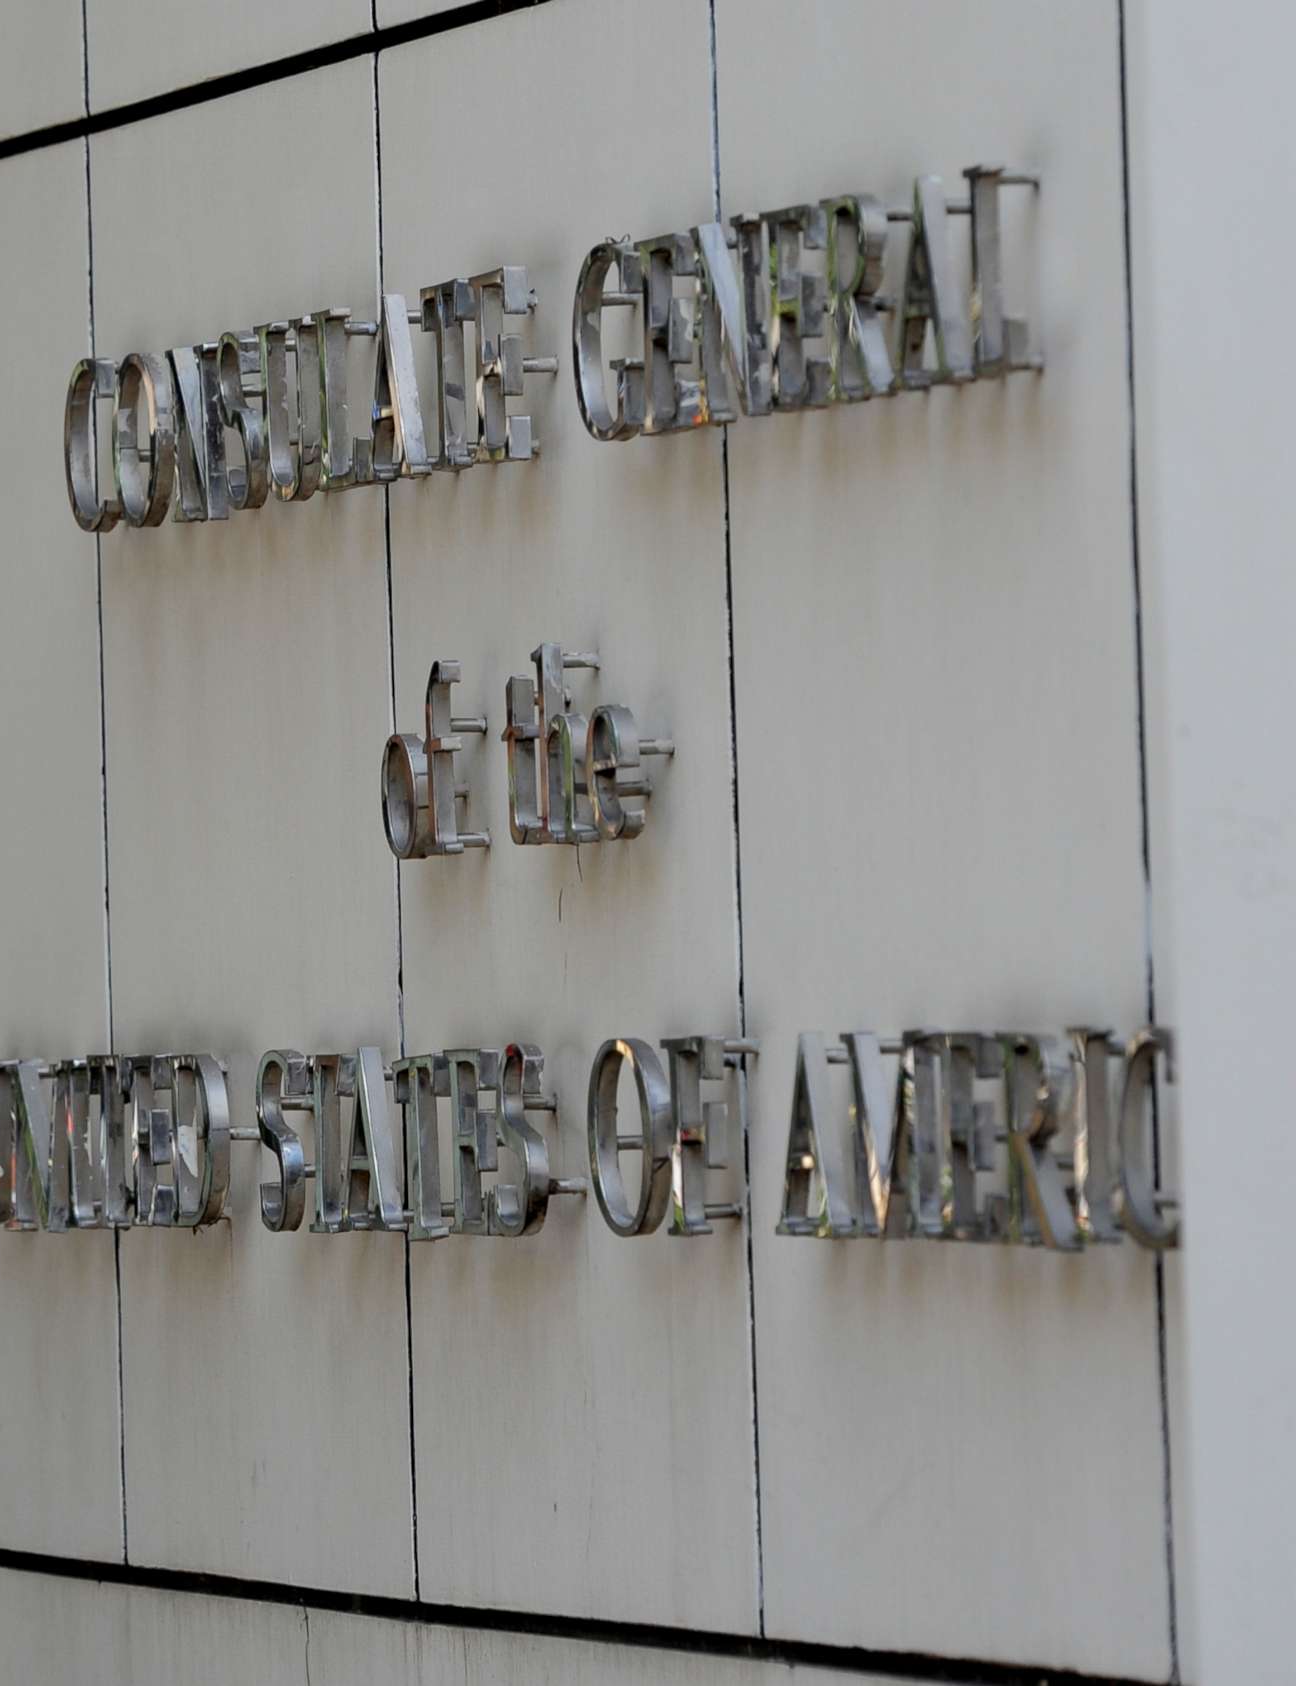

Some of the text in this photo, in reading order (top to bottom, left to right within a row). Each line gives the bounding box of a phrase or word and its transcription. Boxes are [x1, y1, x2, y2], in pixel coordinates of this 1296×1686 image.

[65, 166, 1030, 532] CONSULATE GENERAL
[382, 642, 646, 859] of the
[256, 1043, 550, 1240] STATES
[587, 1035, 727, 1238] OF
